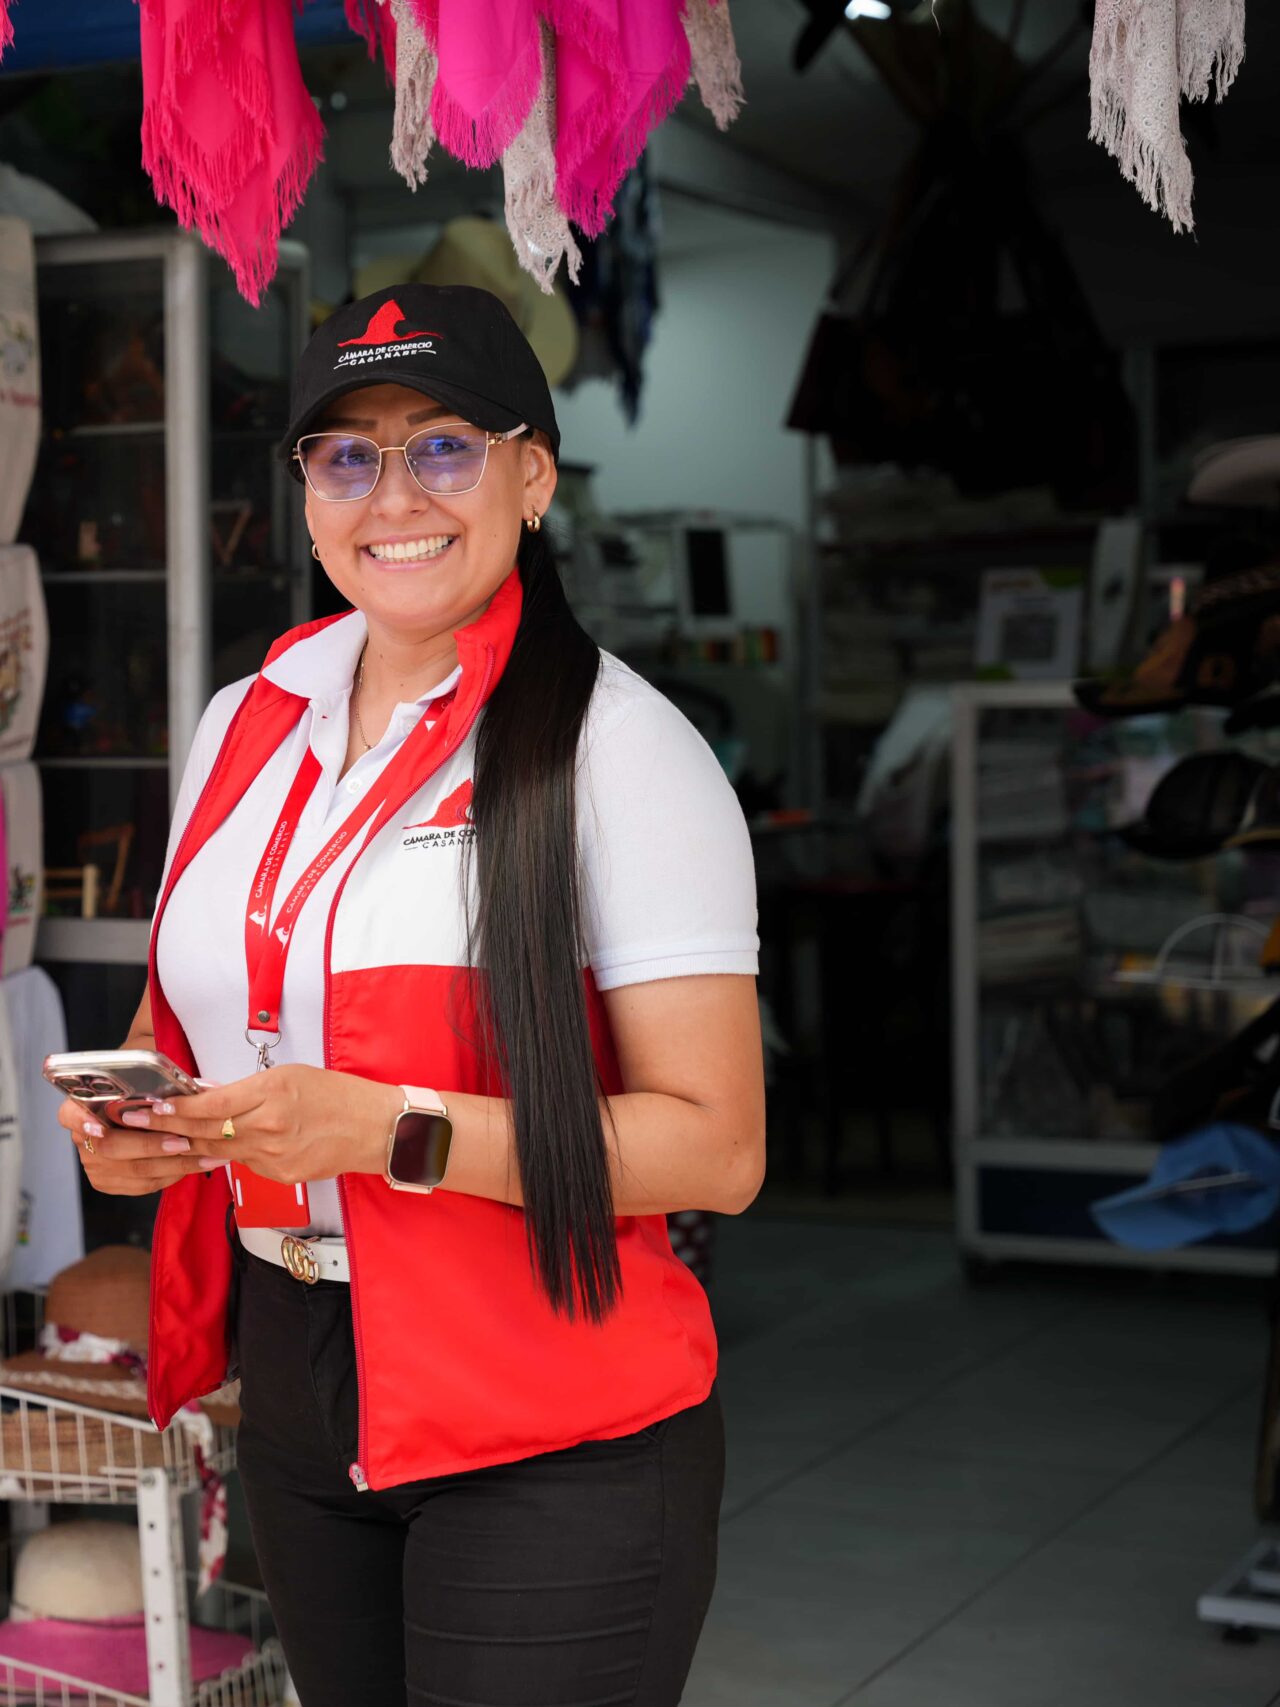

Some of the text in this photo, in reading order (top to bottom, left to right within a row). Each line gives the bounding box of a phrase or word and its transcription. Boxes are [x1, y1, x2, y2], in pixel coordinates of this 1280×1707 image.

[375, 346, 387, 355] DE
[387, 341, 433, 352] COMERCIO
[349, 350, 418, 366] CASANARE
[265, 857, 273, 866] DE
[269, 820, 287, 855] COMERCIO
[444, 831, 456, 839] DE
[307, 868, 317, 878] DE
[316, 831, 347, 868] COMERCIO
